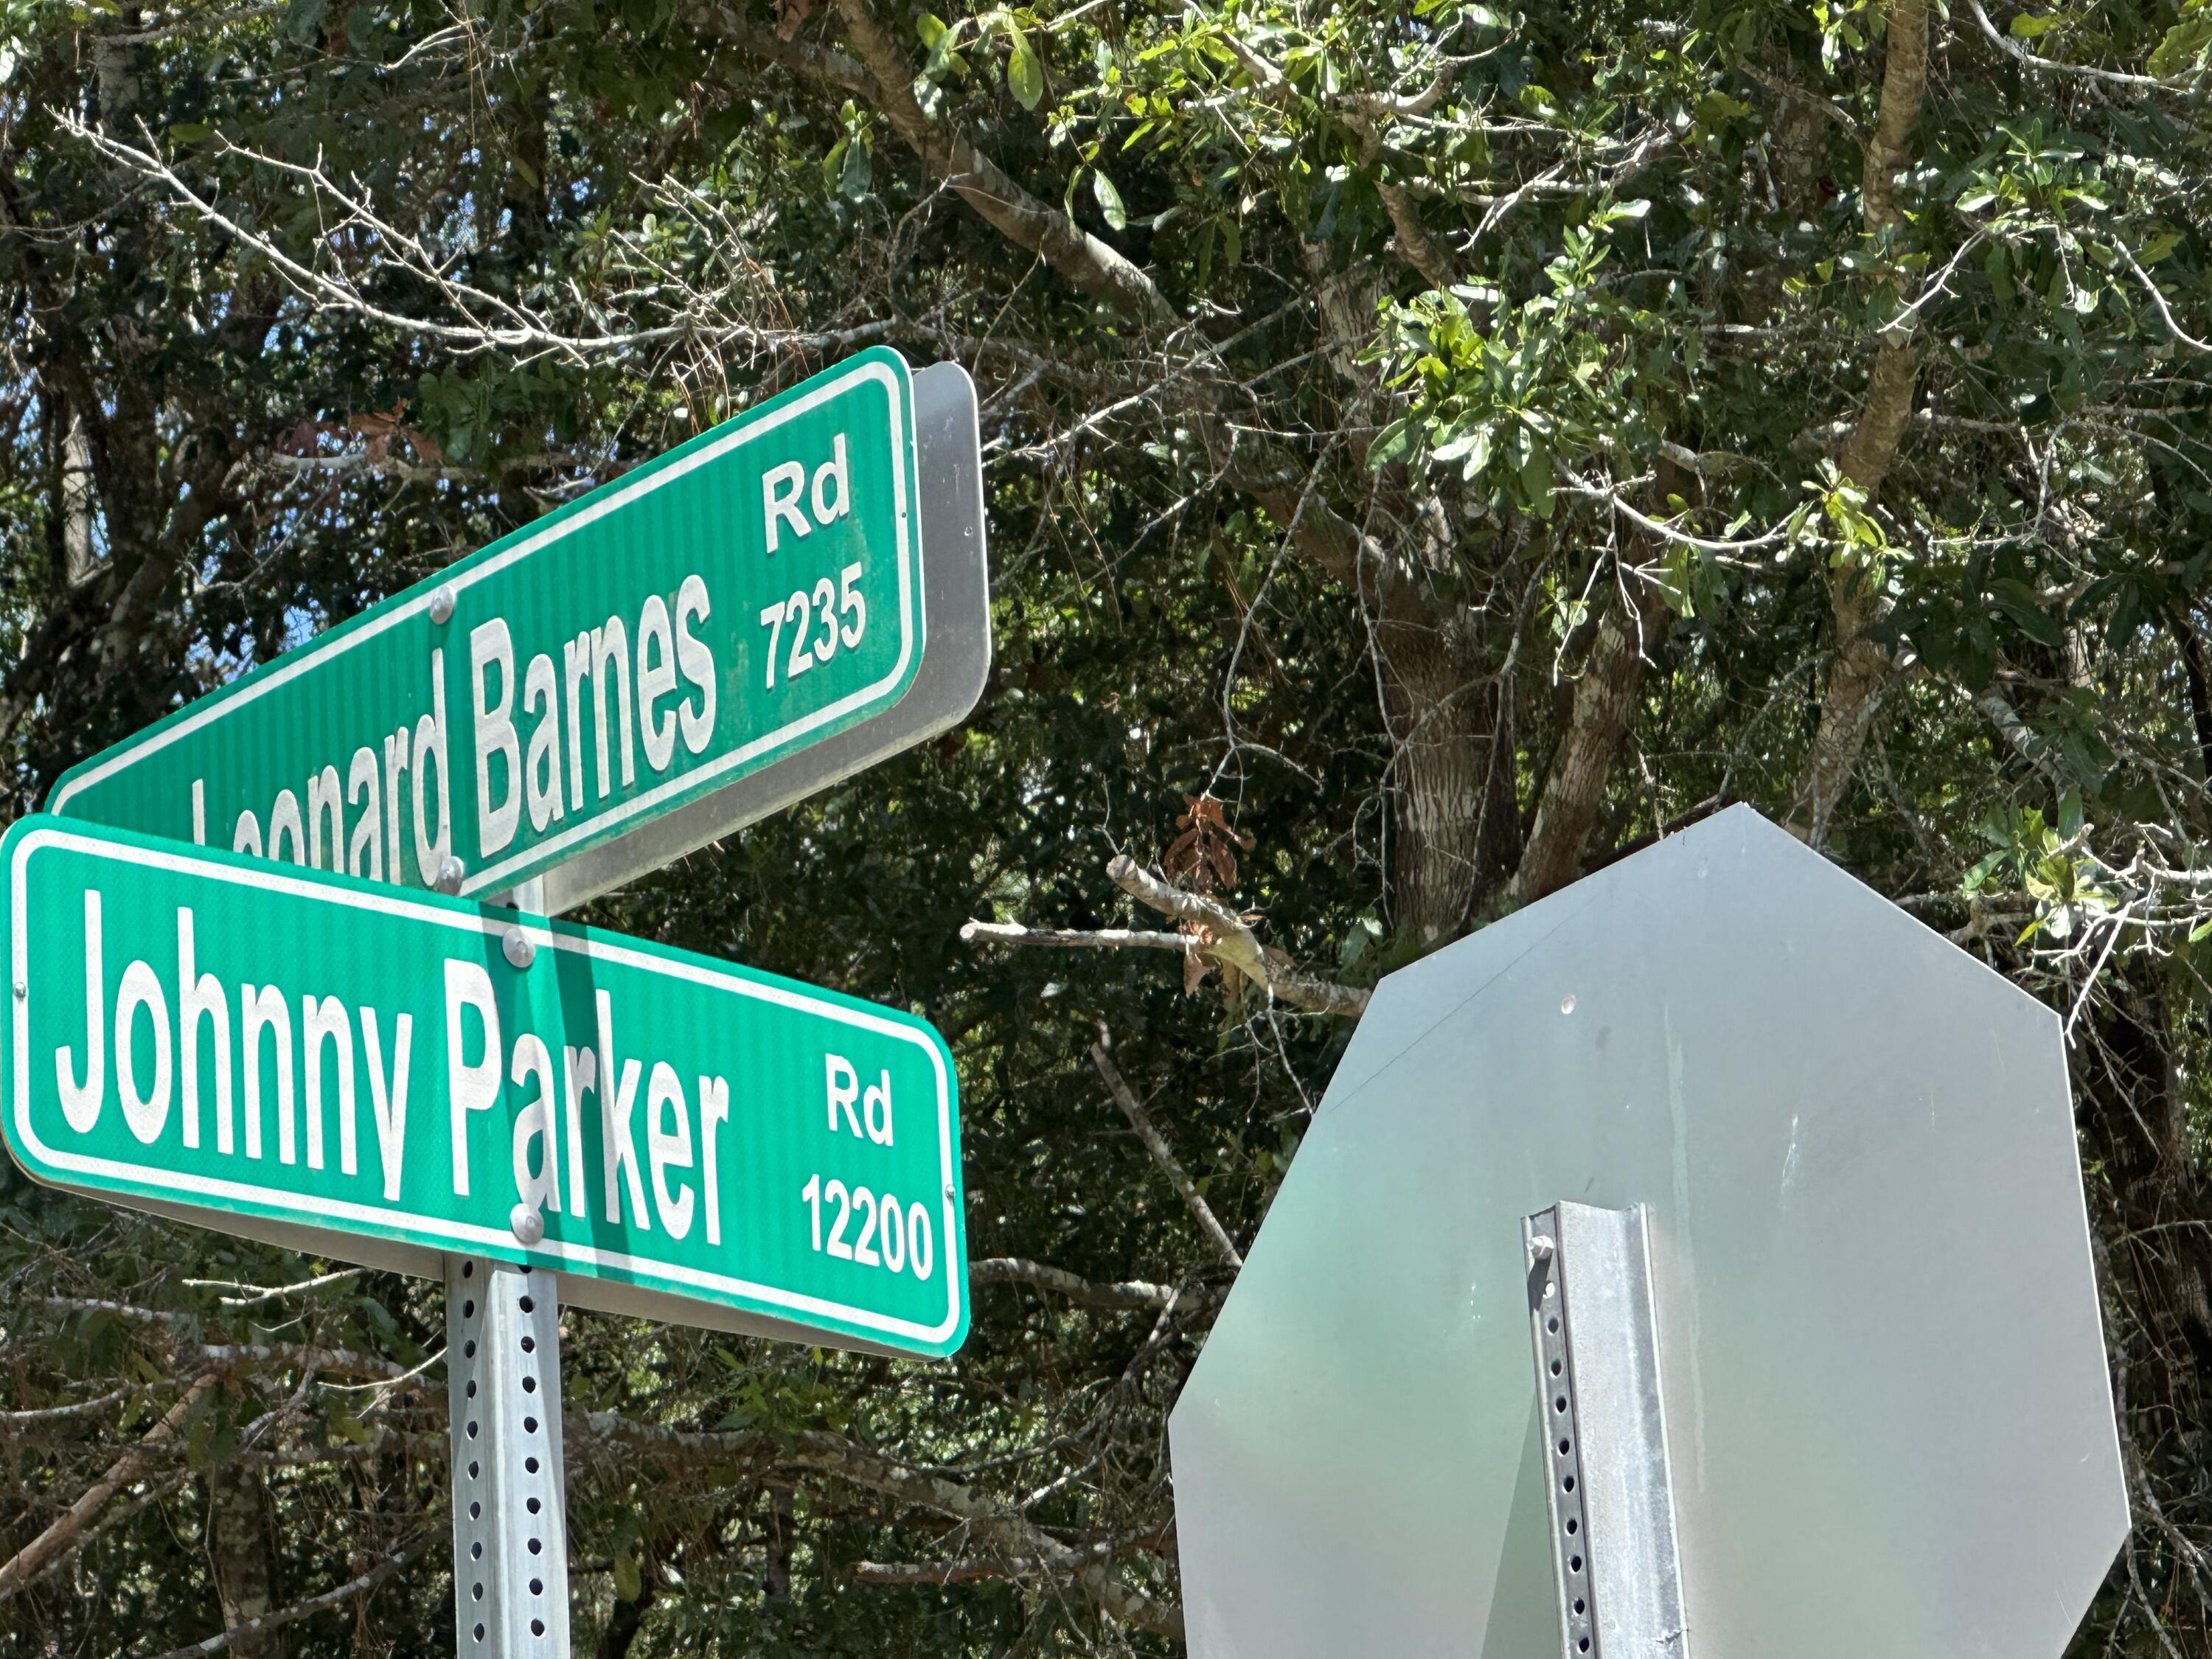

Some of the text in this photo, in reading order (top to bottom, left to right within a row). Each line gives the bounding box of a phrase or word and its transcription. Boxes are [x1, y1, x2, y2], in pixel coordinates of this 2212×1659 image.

[762, 432, 850, 554] Rd
[760, 561, 866, 689] 7235
[192, 574, 716, 886] nard Barnes
[55, 888, 729, 1246] Johnny Parker
[825, 1053, 894, 1147] Rd
[801, 1174, 933, 1281] 12200
